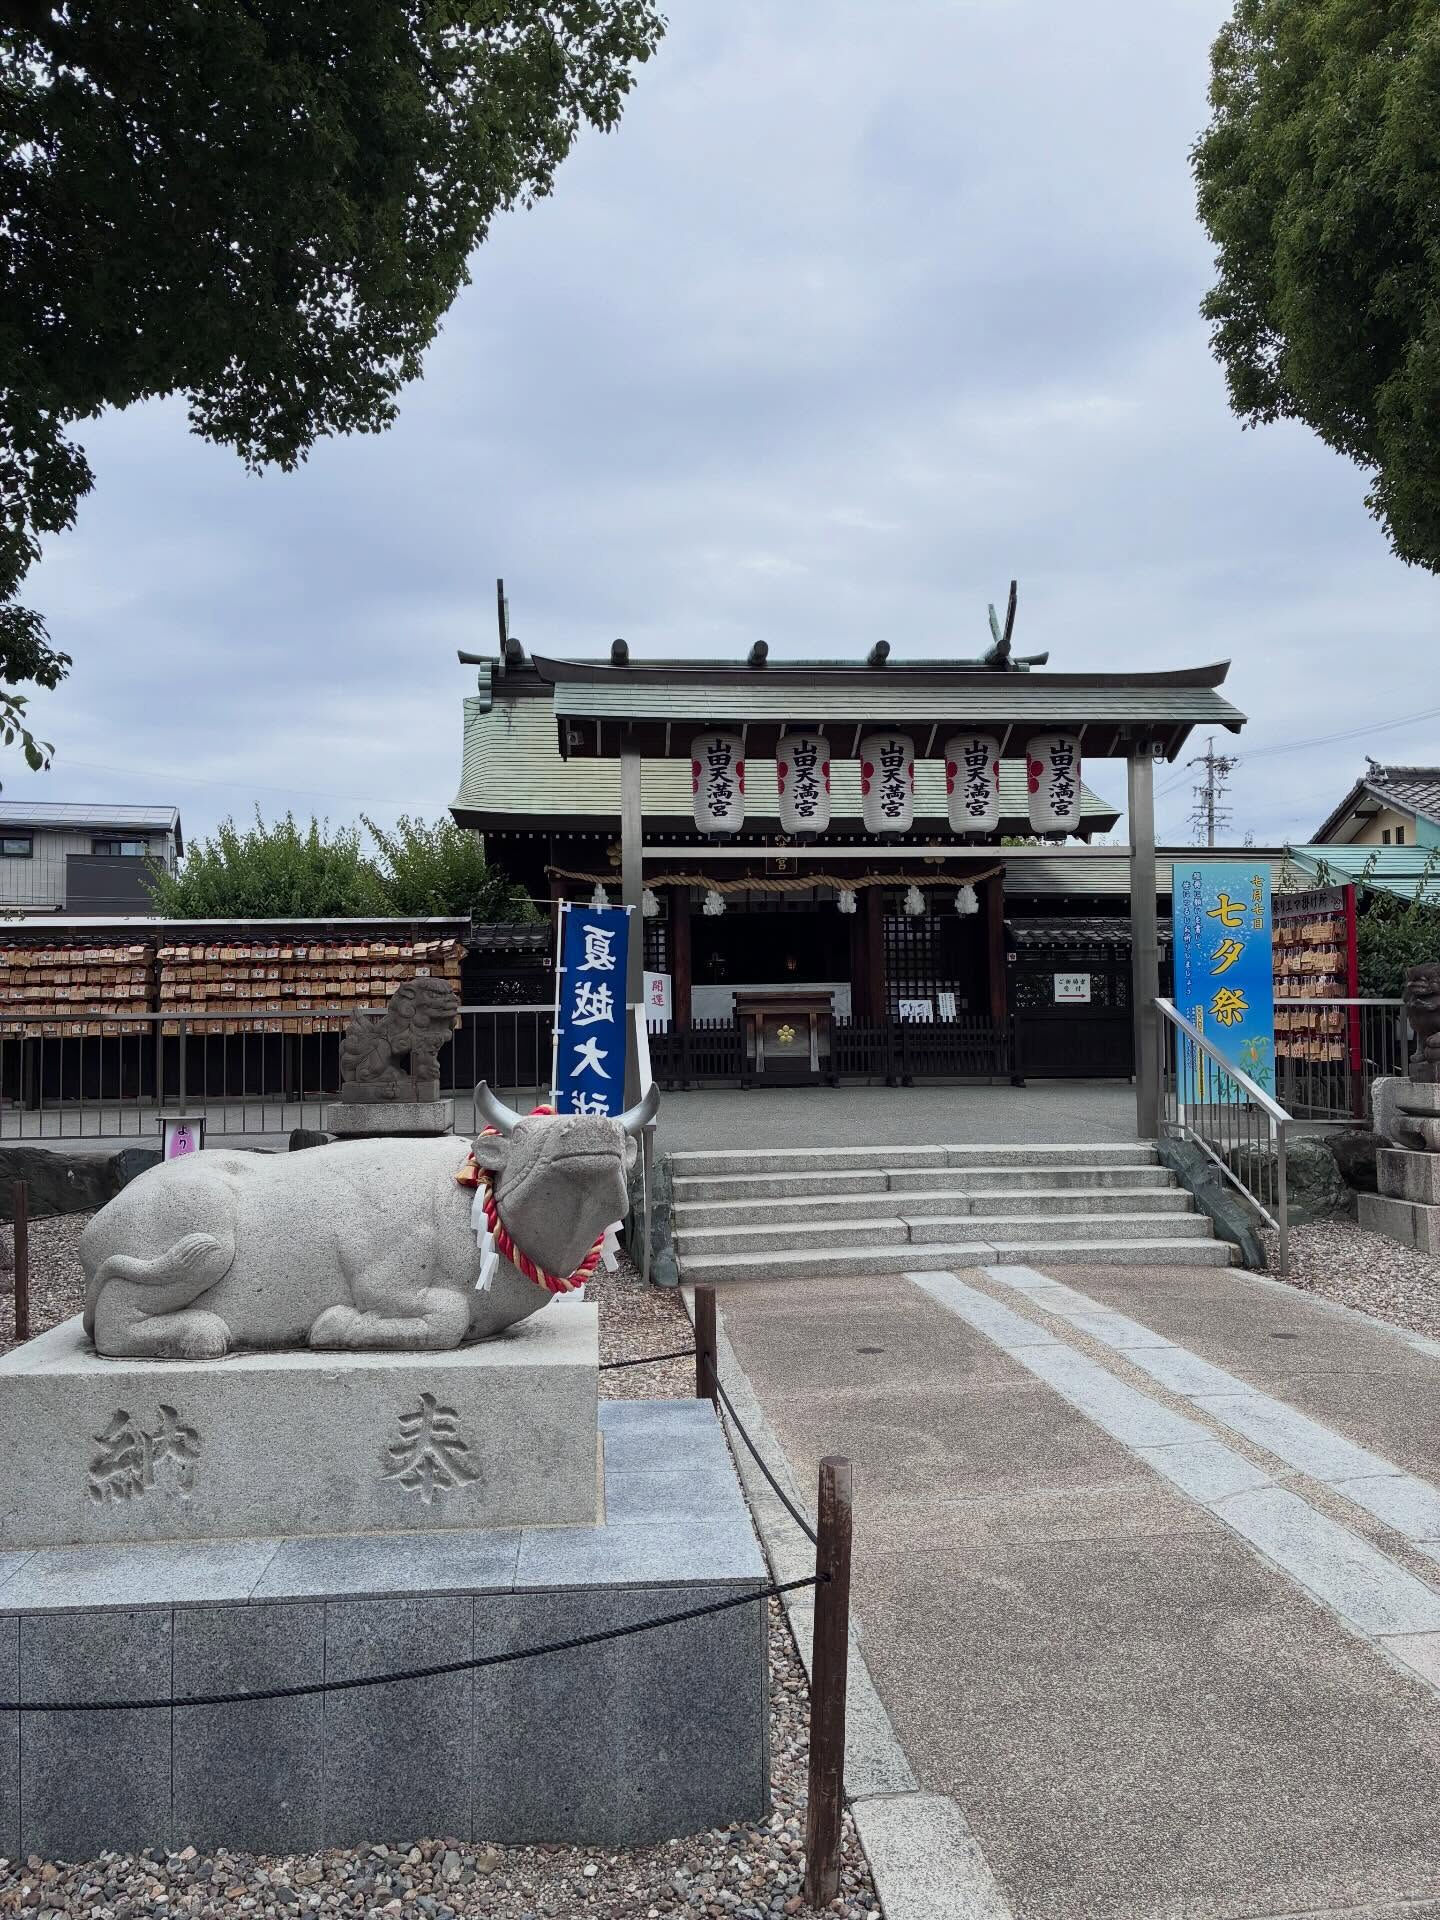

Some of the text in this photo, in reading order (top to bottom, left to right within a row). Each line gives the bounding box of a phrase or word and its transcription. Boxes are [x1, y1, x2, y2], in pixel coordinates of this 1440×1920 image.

[707, 738, 734, 818] 山田天満宮
[793, 739, 820, 818] 山田天満宮
[879, 740, 906, 818] 山田天満宮
[963, 740, 991, 817] 山田天満宮
[1048, 739, 1077, 817] 山田天満宮
[1251, 875, 1265, 929] 七月七日
[651, 979, 665, 1007] 開運
[1206, 893, 1250, 1027] 七夕祭
